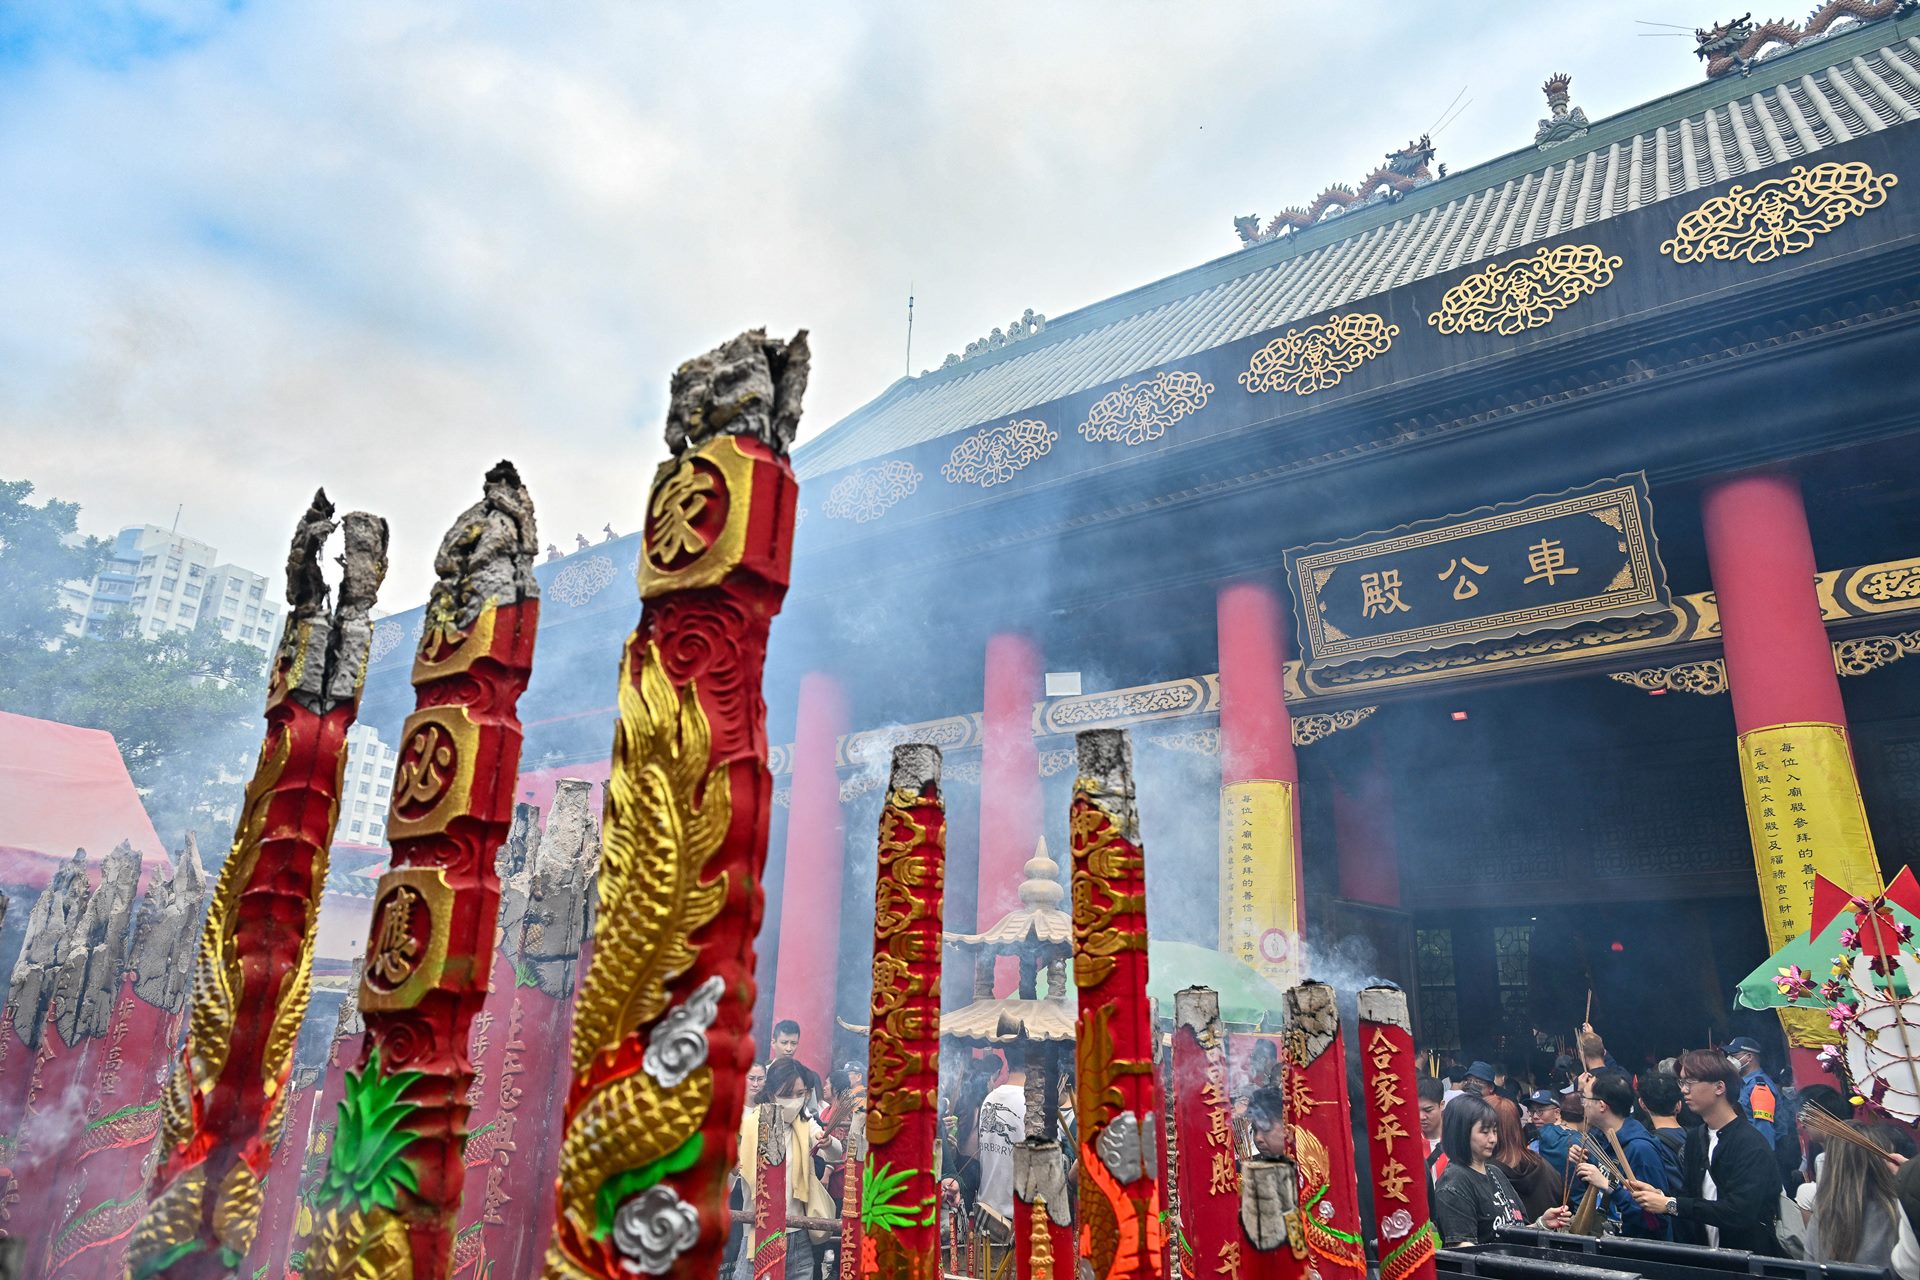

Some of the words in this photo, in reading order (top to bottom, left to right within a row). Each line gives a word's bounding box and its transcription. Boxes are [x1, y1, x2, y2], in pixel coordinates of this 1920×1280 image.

[648, 460, 712, 563] 家
[1360, 538, 1579, 618] 車公殿
[979, 1142, 1013, 1157] URBERRY
[1366, 1027, 1413, 1203] 合家平安
